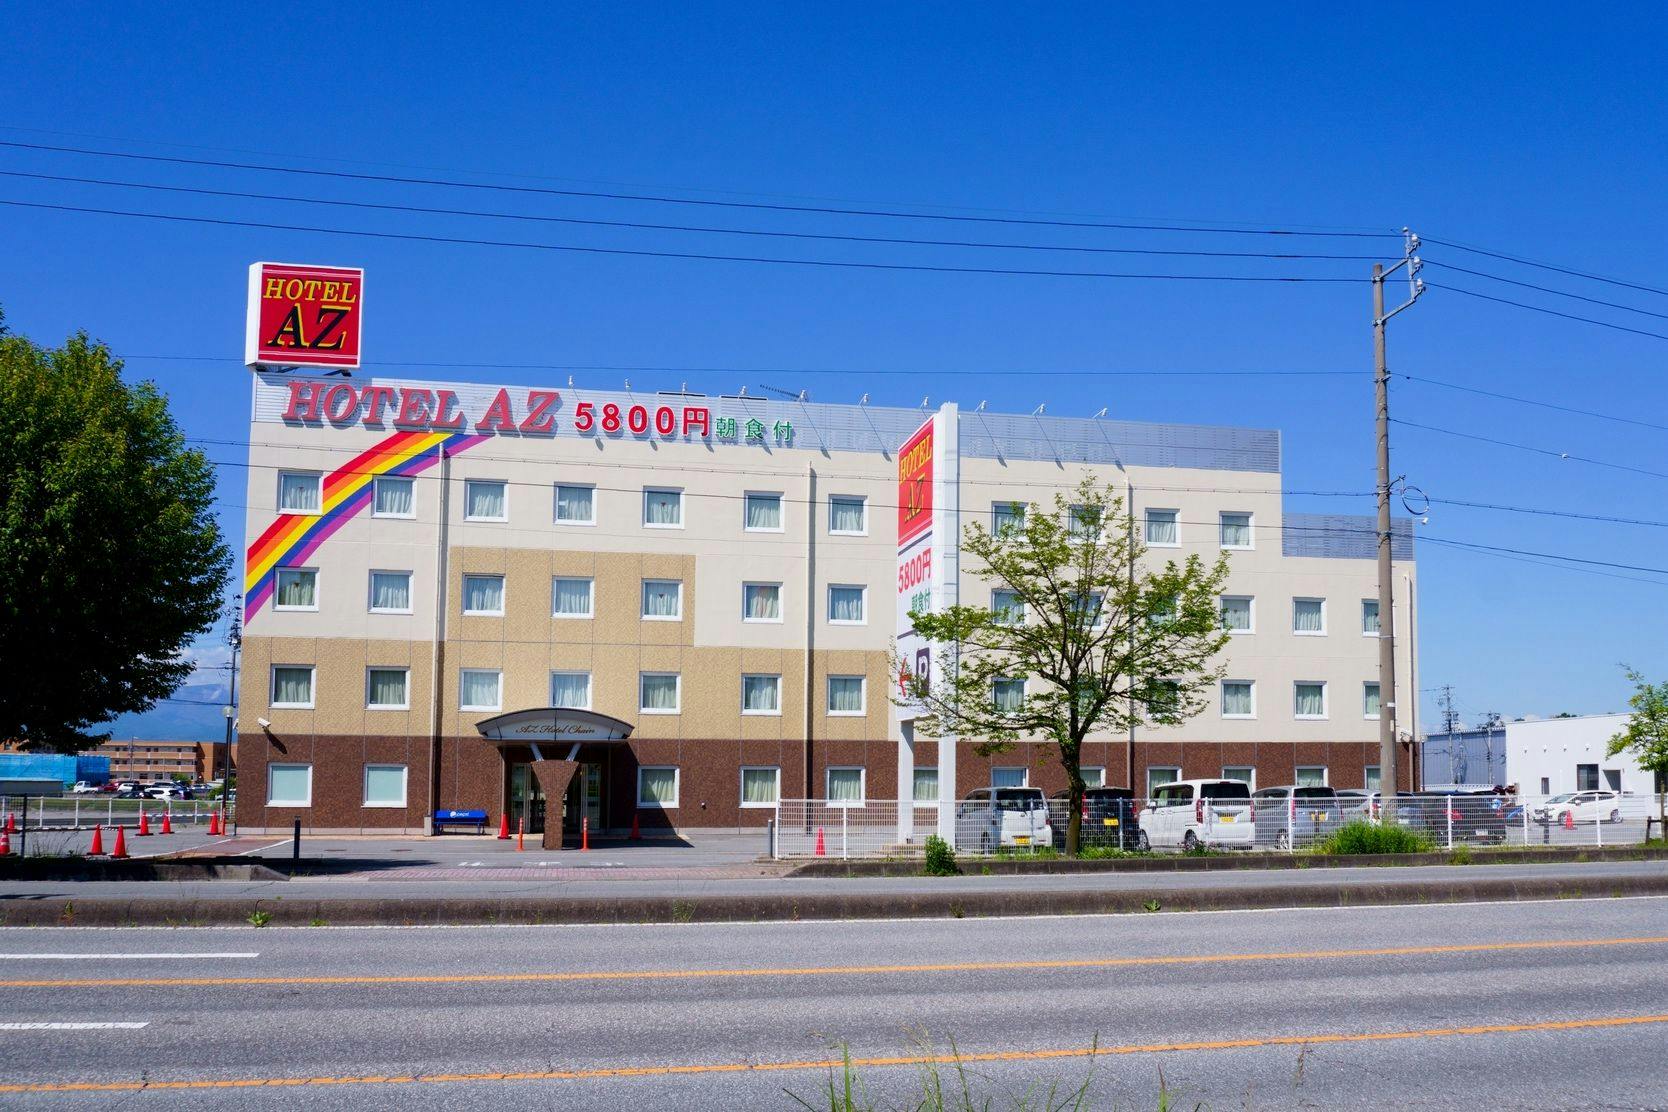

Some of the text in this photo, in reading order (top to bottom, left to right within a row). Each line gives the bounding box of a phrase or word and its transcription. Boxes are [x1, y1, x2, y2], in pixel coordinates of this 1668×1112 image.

[263, 278, 356, 303] HOTEL
[266, 303, 351, 350] AZ
[281, 381, 561, 434] HOTEL AZ
[574, 402, 793, 442] 5800円 朝食付
[899, 433, 932, 485] HOTEL
[905, 472, 926, 524] AZ
[899, 547, 932, 594] 5800円
[539, 725, 567, 734] Hotel
[568, 724, 595, 735] Chain
